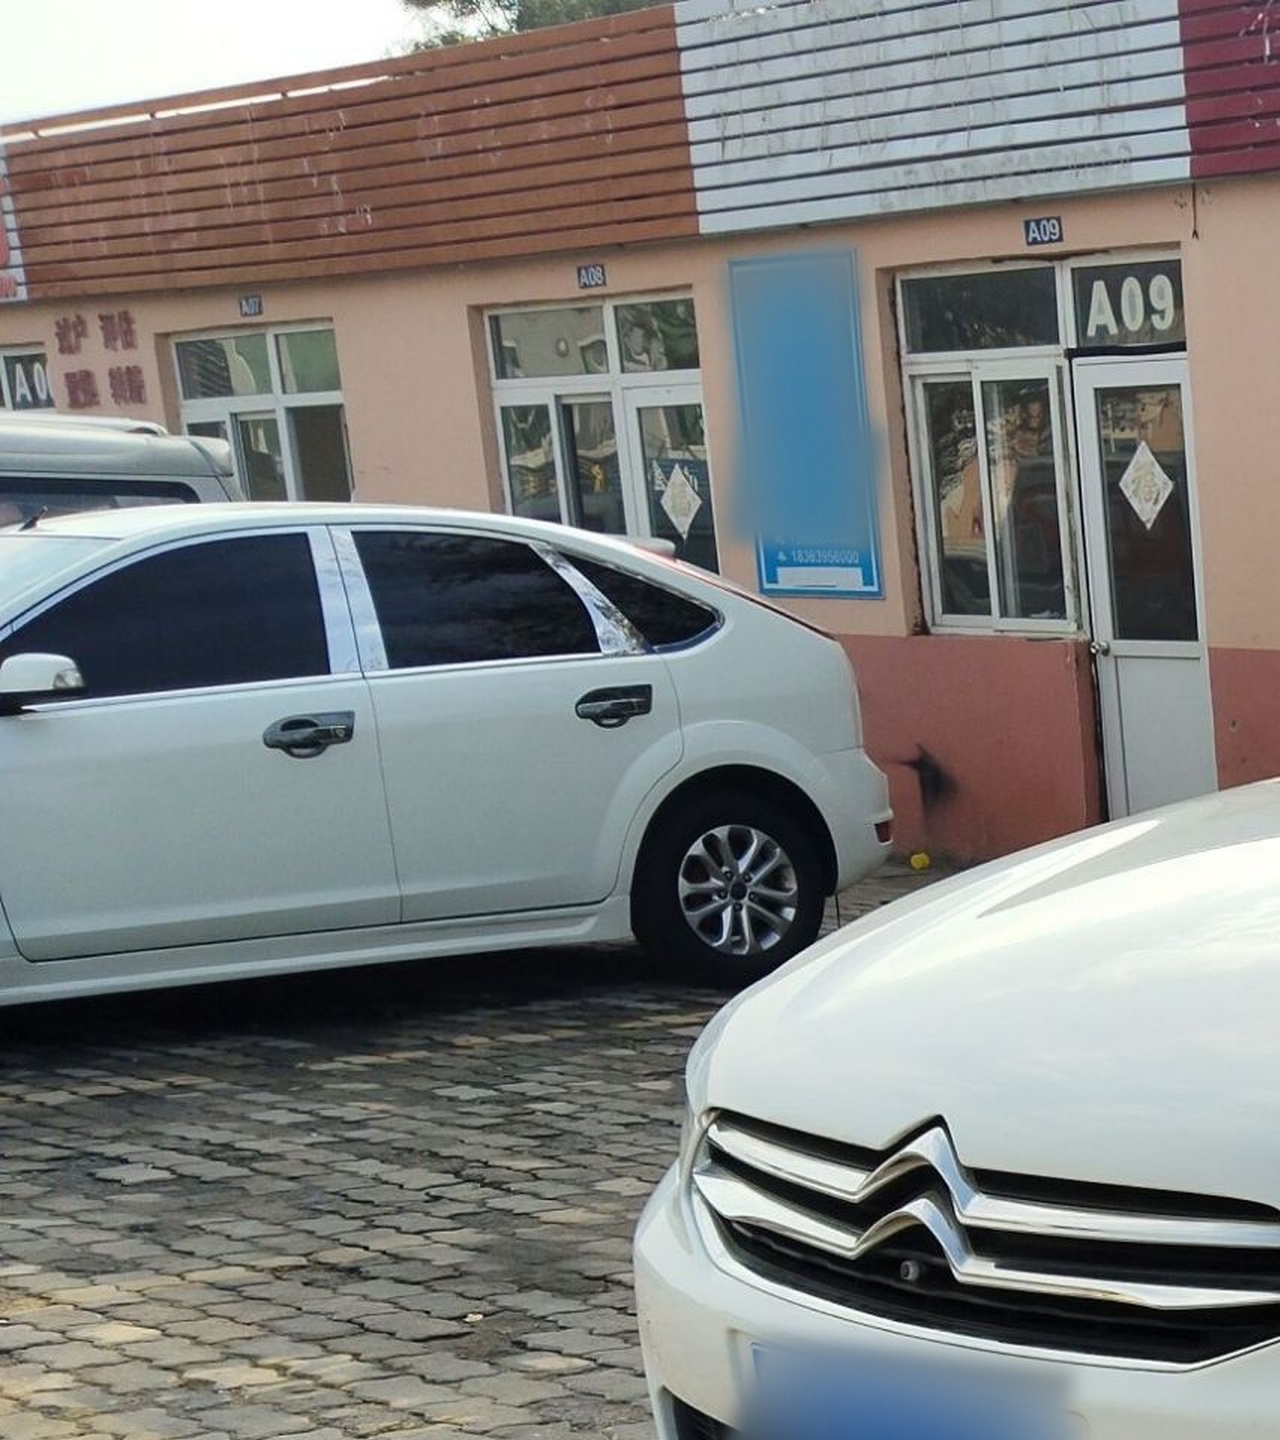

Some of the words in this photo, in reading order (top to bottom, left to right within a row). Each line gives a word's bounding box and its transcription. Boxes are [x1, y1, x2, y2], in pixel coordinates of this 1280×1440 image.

[1027, 218, 1061, 243] A09
[579, 265, 604, 287] A08
[241, 296, 261, 315] A07
[1086, 273, 1175, 338] A09
